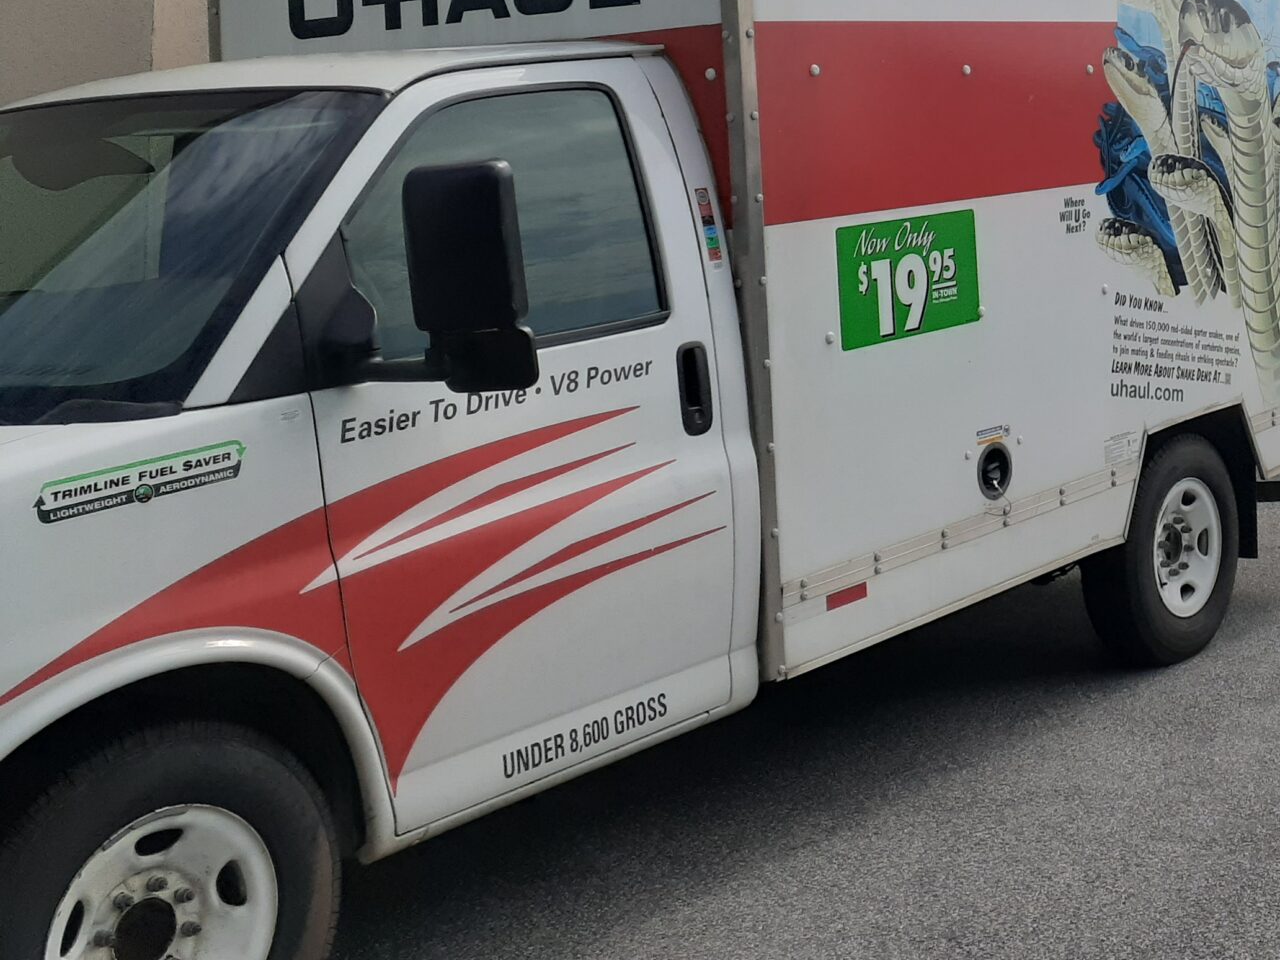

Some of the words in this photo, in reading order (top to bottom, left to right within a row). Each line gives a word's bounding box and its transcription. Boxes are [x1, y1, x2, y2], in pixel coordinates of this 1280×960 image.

[1059, 210, 1072, 222] Will
[1074, 209, 1080, 223] U
[1082, 209, 1091, 219] Go
[1064, 197, 1085, 208] Where
[853, 227, 892, 258] Now
[894, 220, 937, 257] Only
[1145, 320, 1169, 332] 150,000
[1150, 348, 1155, 358] &
[339, 409, 421, 444] Easier
[429, 398, 457, 423] To
[465, 388, 527, 416] Drive
[549, 370, 579, 396] V8
[585, 359, 653, 389] Power
[1111, 379, 1184, 402] uhaul.com
[50, 475, 130, 503] TRIMLINE
[138, 464, 177, 482] FUEL
[50, 494, 128, 521] LIGHTWEIGHT
[159, 469, 234, 494] AERODYNAMIC
[502, 733, 565, 779] UNDER
[569, 716, 610, 753] 8,600
[614, 693, 668, 735] GROSS
